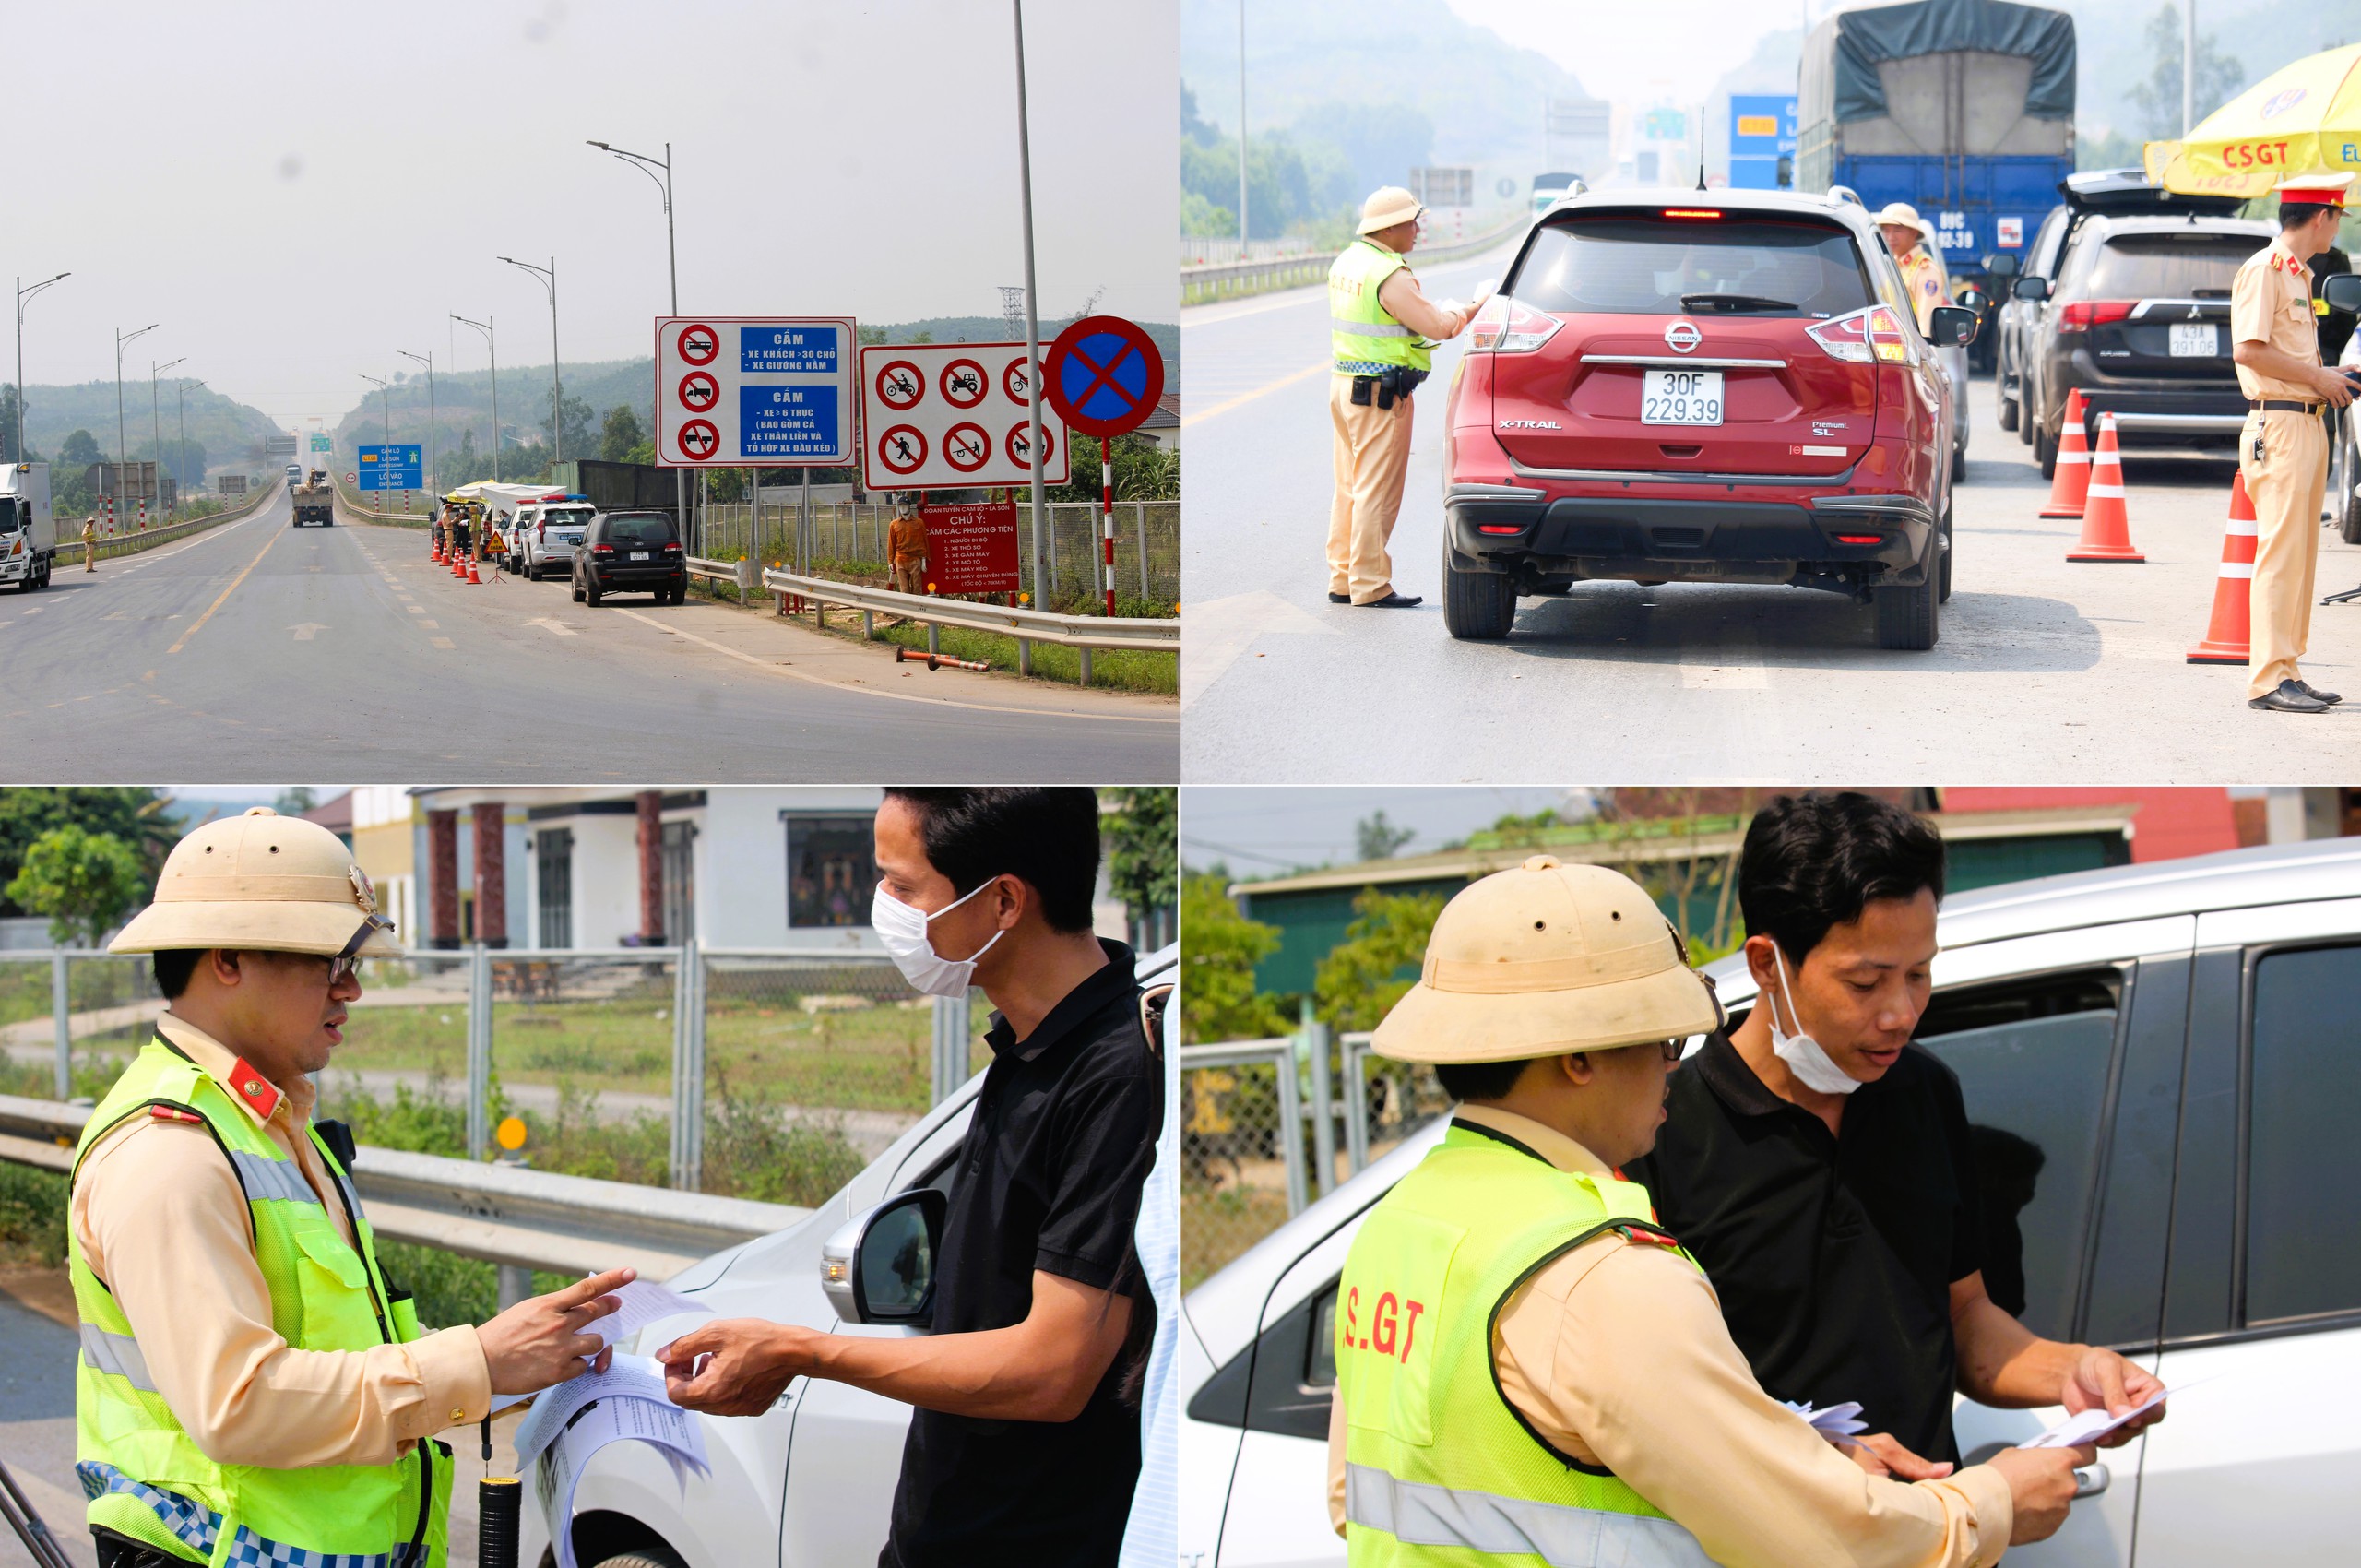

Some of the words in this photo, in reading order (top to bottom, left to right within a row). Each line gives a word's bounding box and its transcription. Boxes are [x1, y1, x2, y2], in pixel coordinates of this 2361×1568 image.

[2223, 143, 2288, 168] CSGT
[774, 329, 803, 344] CẤM
[2182, 326, 2204, 339] 43A
[763, 348, 795, 358] KHÁCH
[817, 347, 835, 358] CHỖ
[767, 360, 802, 369] GIƯỜNG
[1663, 374, 1704, 396] 30F
[773, 387, 803, 403] CẤM
[790, 409, 814, 418] TRỤC
[1646, 399, 1719, 421] 229.39
[781, 419, 800, 428] GỒM
[1499, 420, 1562, 429] X-TRAIL
[764, 431, 787, 440] THÂN
[790, 430, 808, 440] LIỀN
[810, 431, 821, 440] VÀ
[793, 442, 811, 452] ĐẦU
[950, 513, 972, 525] CHÚ
